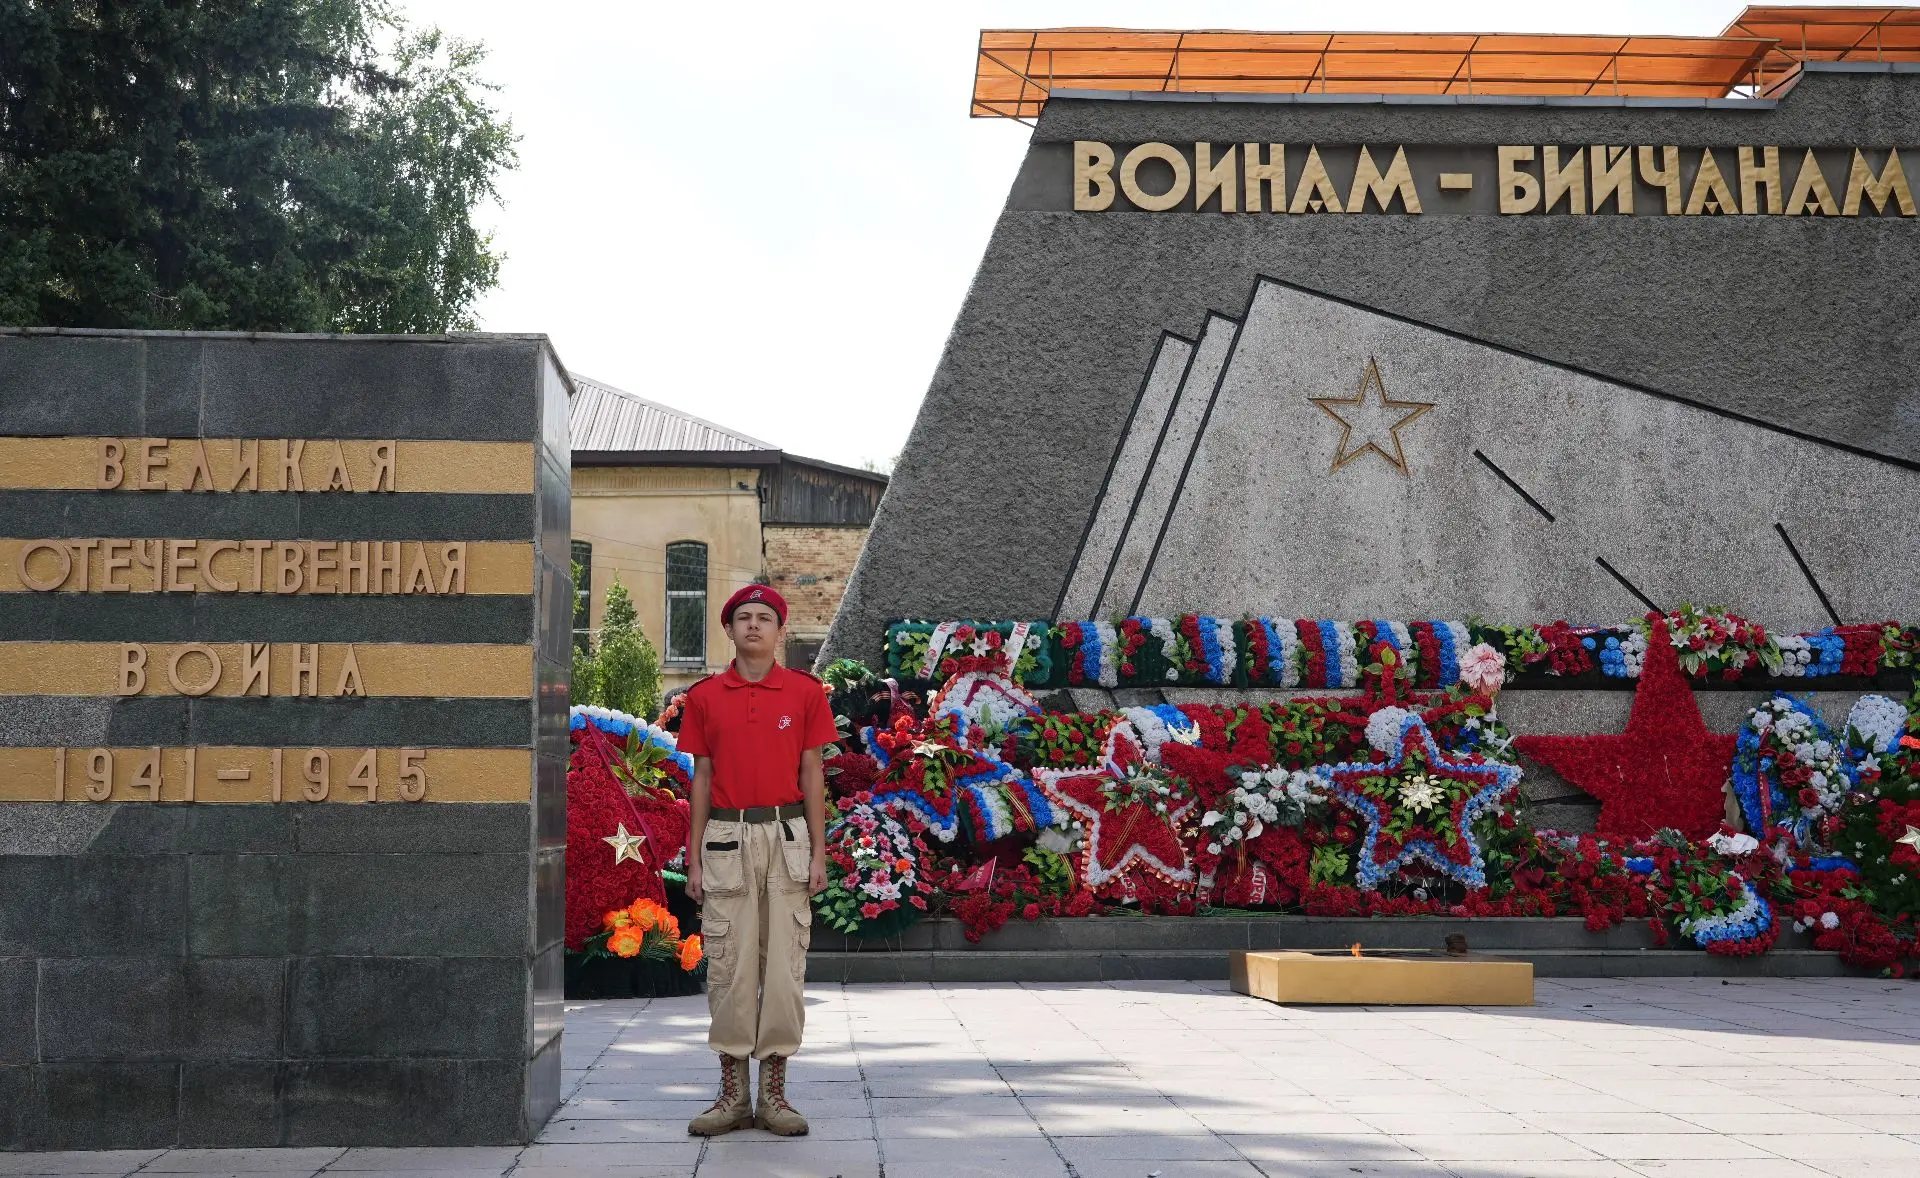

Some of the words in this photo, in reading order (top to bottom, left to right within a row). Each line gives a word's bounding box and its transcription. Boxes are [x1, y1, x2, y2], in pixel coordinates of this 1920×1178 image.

[1073, 140, 1422, 214] ВОИНАМ
[1498, 144, 1918, 216] БИЙЧАНАМ
[97, 437, 398, 492] ВЕЛИКАЯ
[16, 538, 468, 594] ОТЕЧЕСТВЕННАЯ
